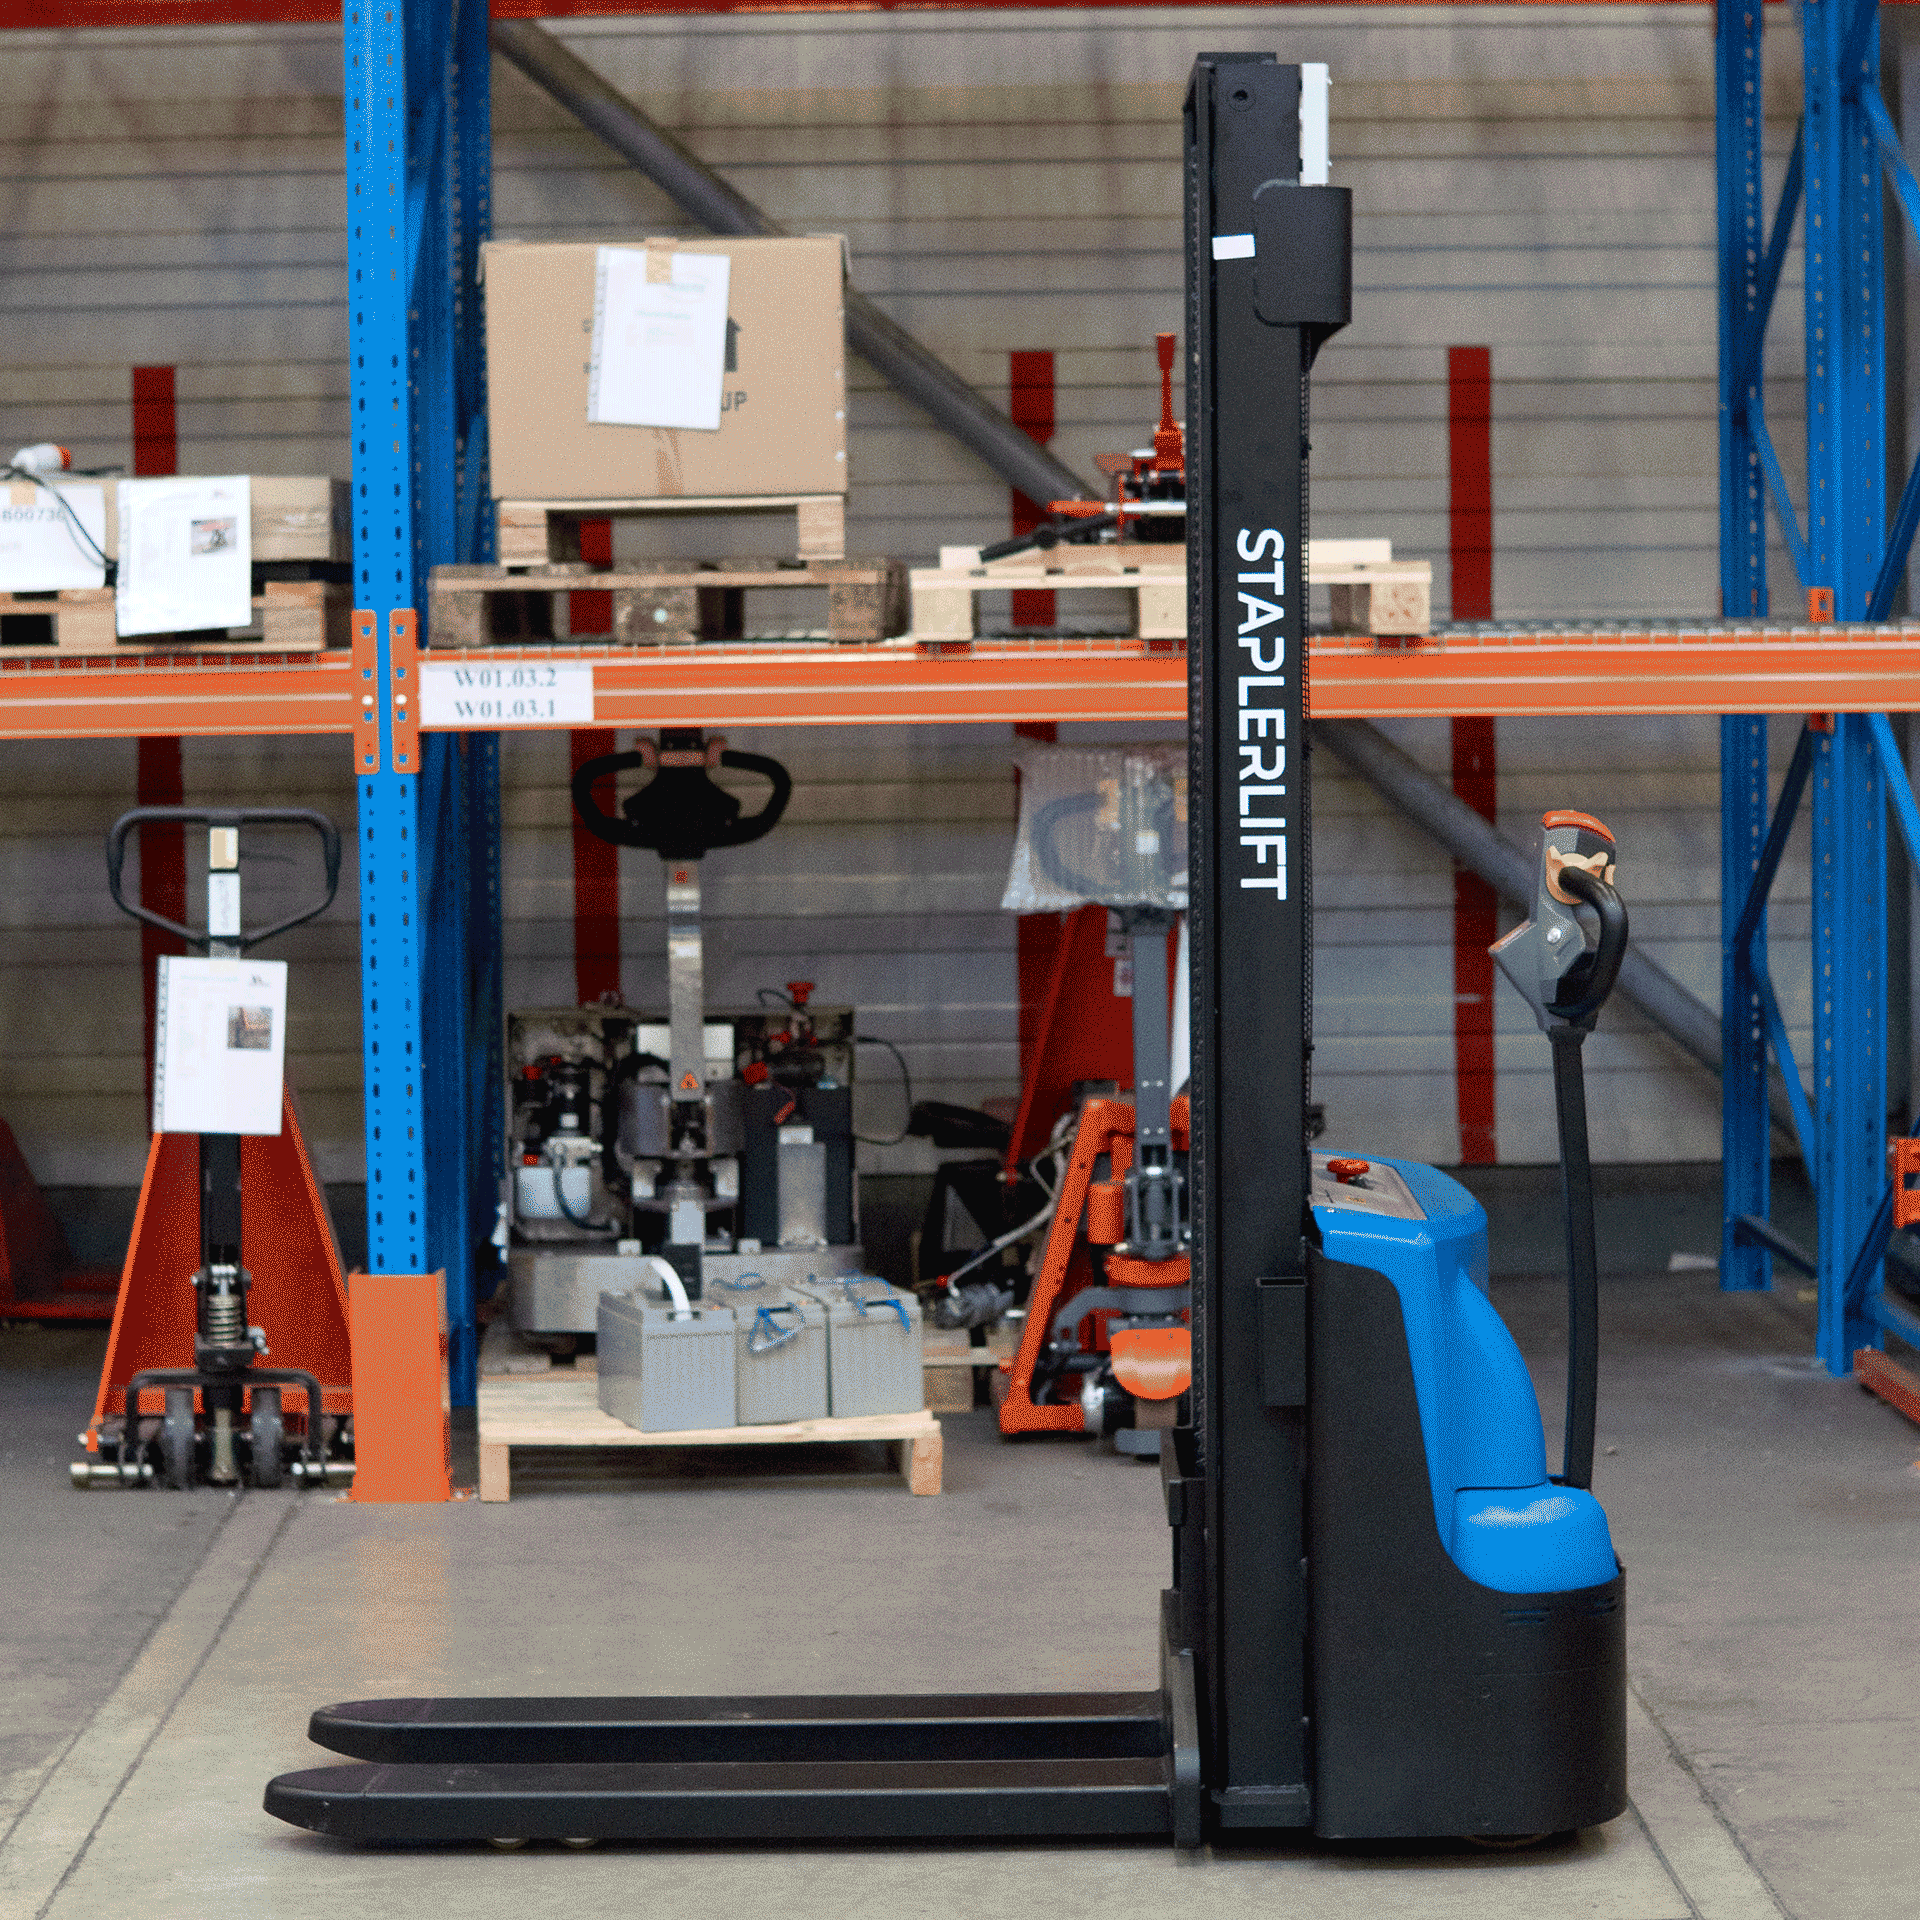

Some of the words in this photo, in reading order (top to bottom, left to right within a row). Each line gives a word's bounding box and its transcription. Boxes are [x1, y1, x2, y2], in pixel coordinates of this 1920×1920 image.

[454, 667, 557, 688] W01.03.2
[454, 699, 555, 718] W01.03.1
[1236, 528, 1287, 900] STAPLERLIFT
